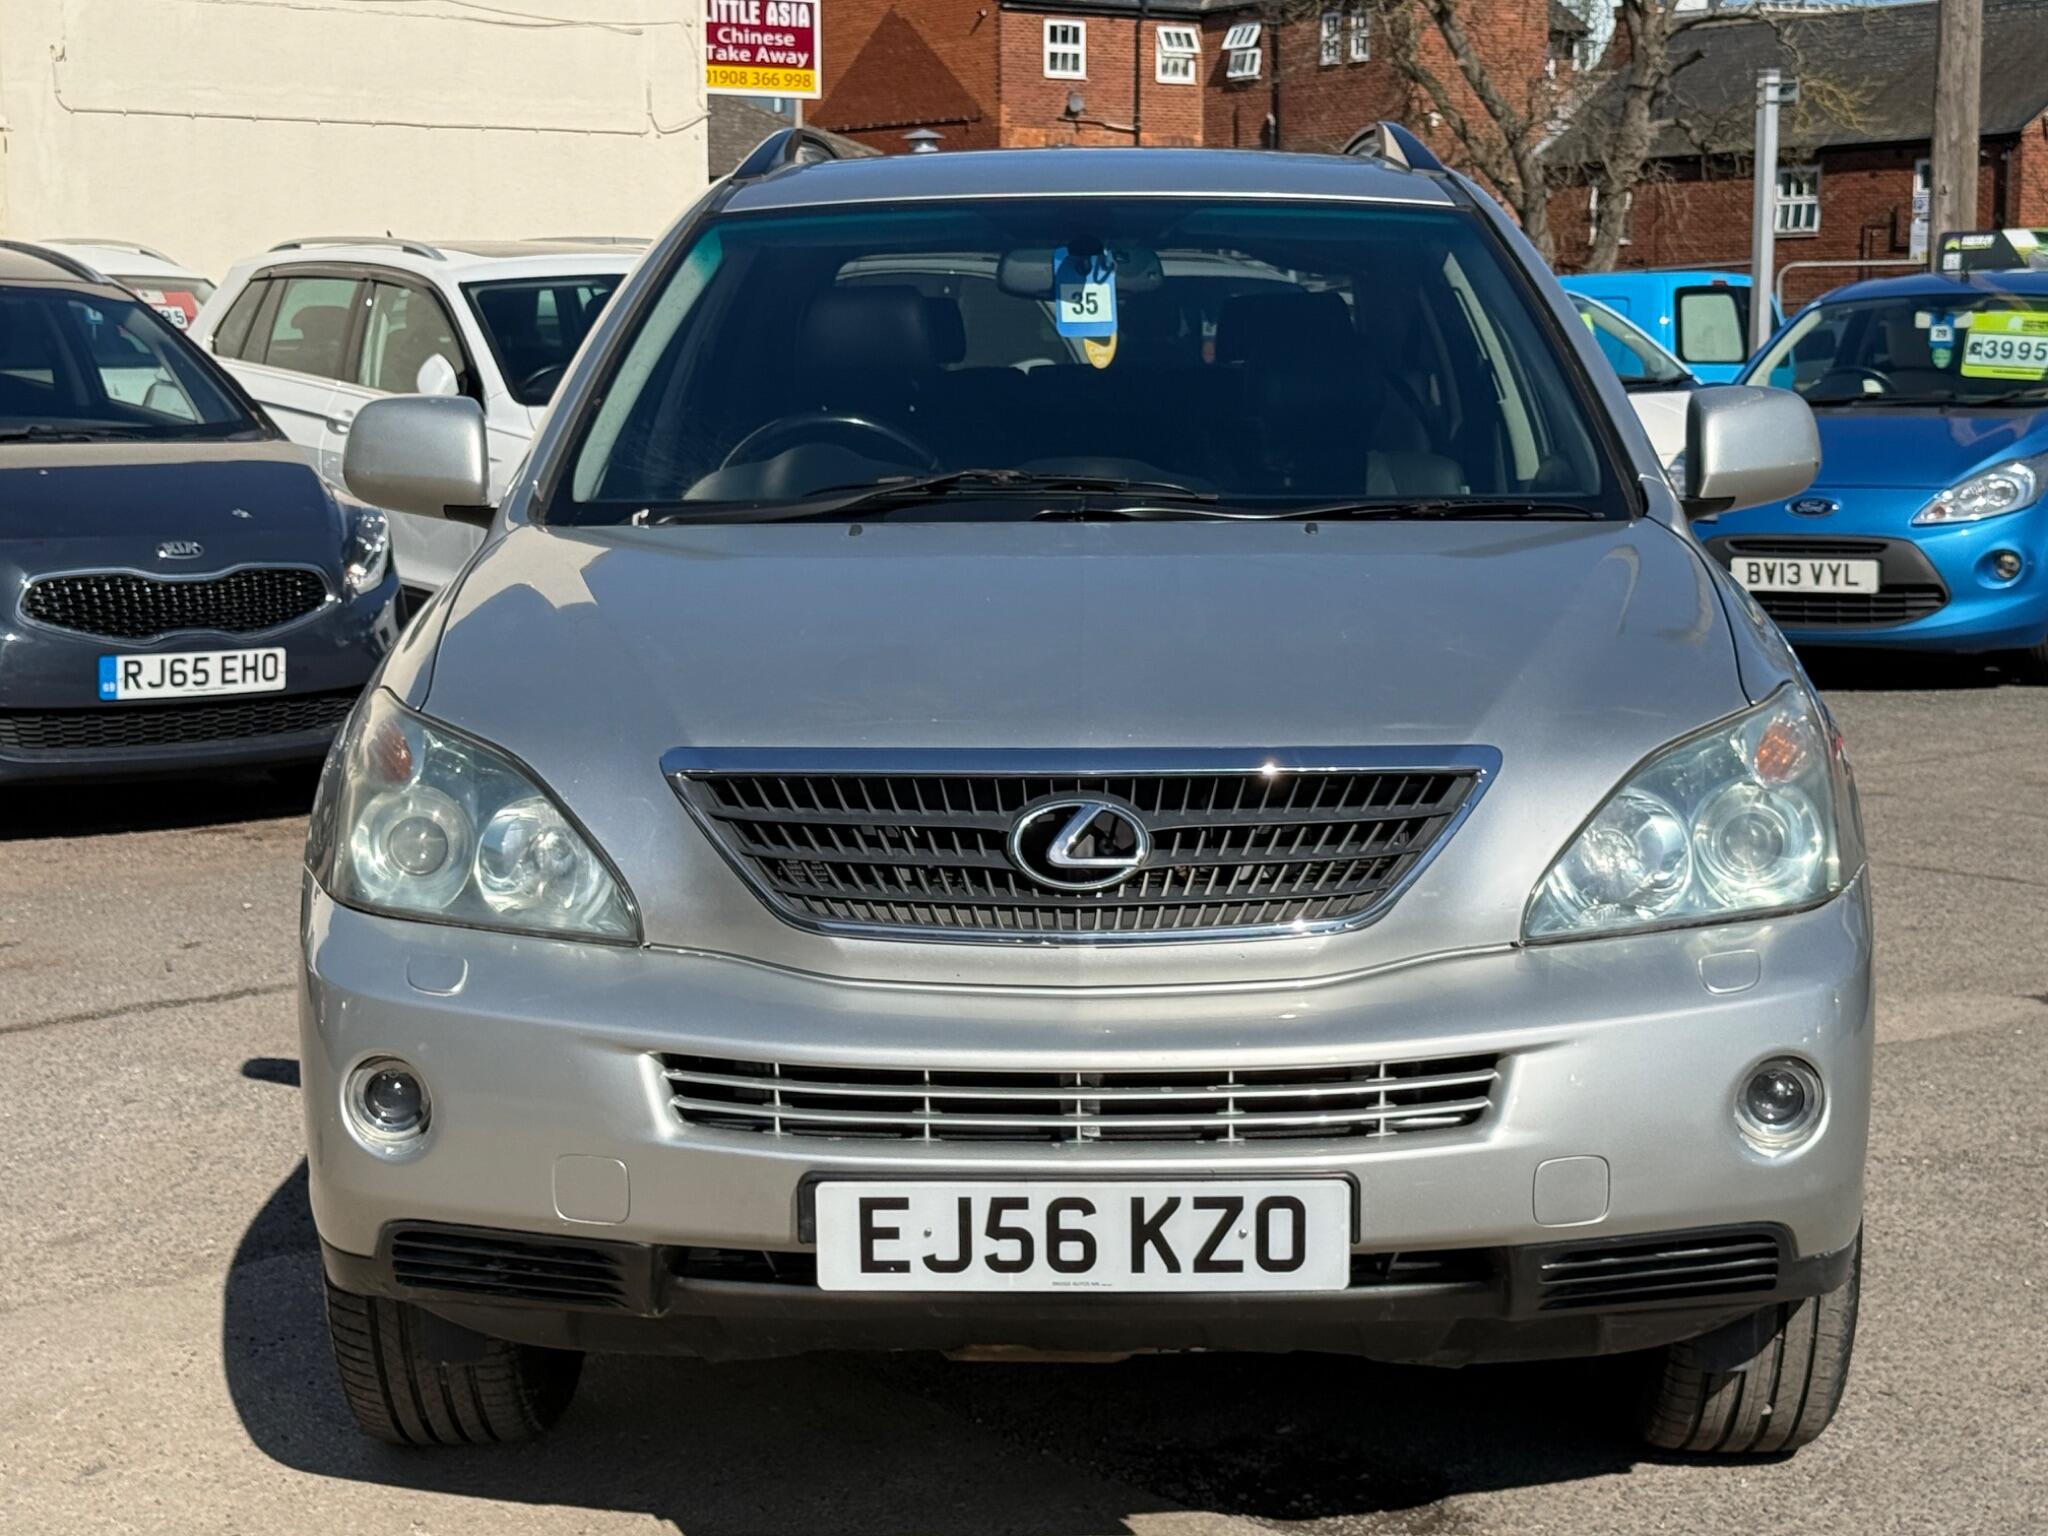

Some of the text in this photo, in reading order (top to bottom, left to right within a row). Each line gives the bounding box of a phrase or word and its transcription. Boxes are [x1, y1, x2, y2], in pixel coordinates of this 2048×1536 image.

[765, 2, 811, 28] ASIA
[717, 27, 796, 47] Chinese
[707, 44, 809, 68] Take Away
[751, 71, 780, 87] 366
[783, 73, 812, 88] 998
[1071, 292, 1099, 315] 35
[1968, 340, 2048, 361] £3995
[1747, 562, 1859, 587] BV13 VYL
[123, 652, 278, 691] RJ65 EHO
[858, 1195, 1307, 1274] EJ56 KZO
